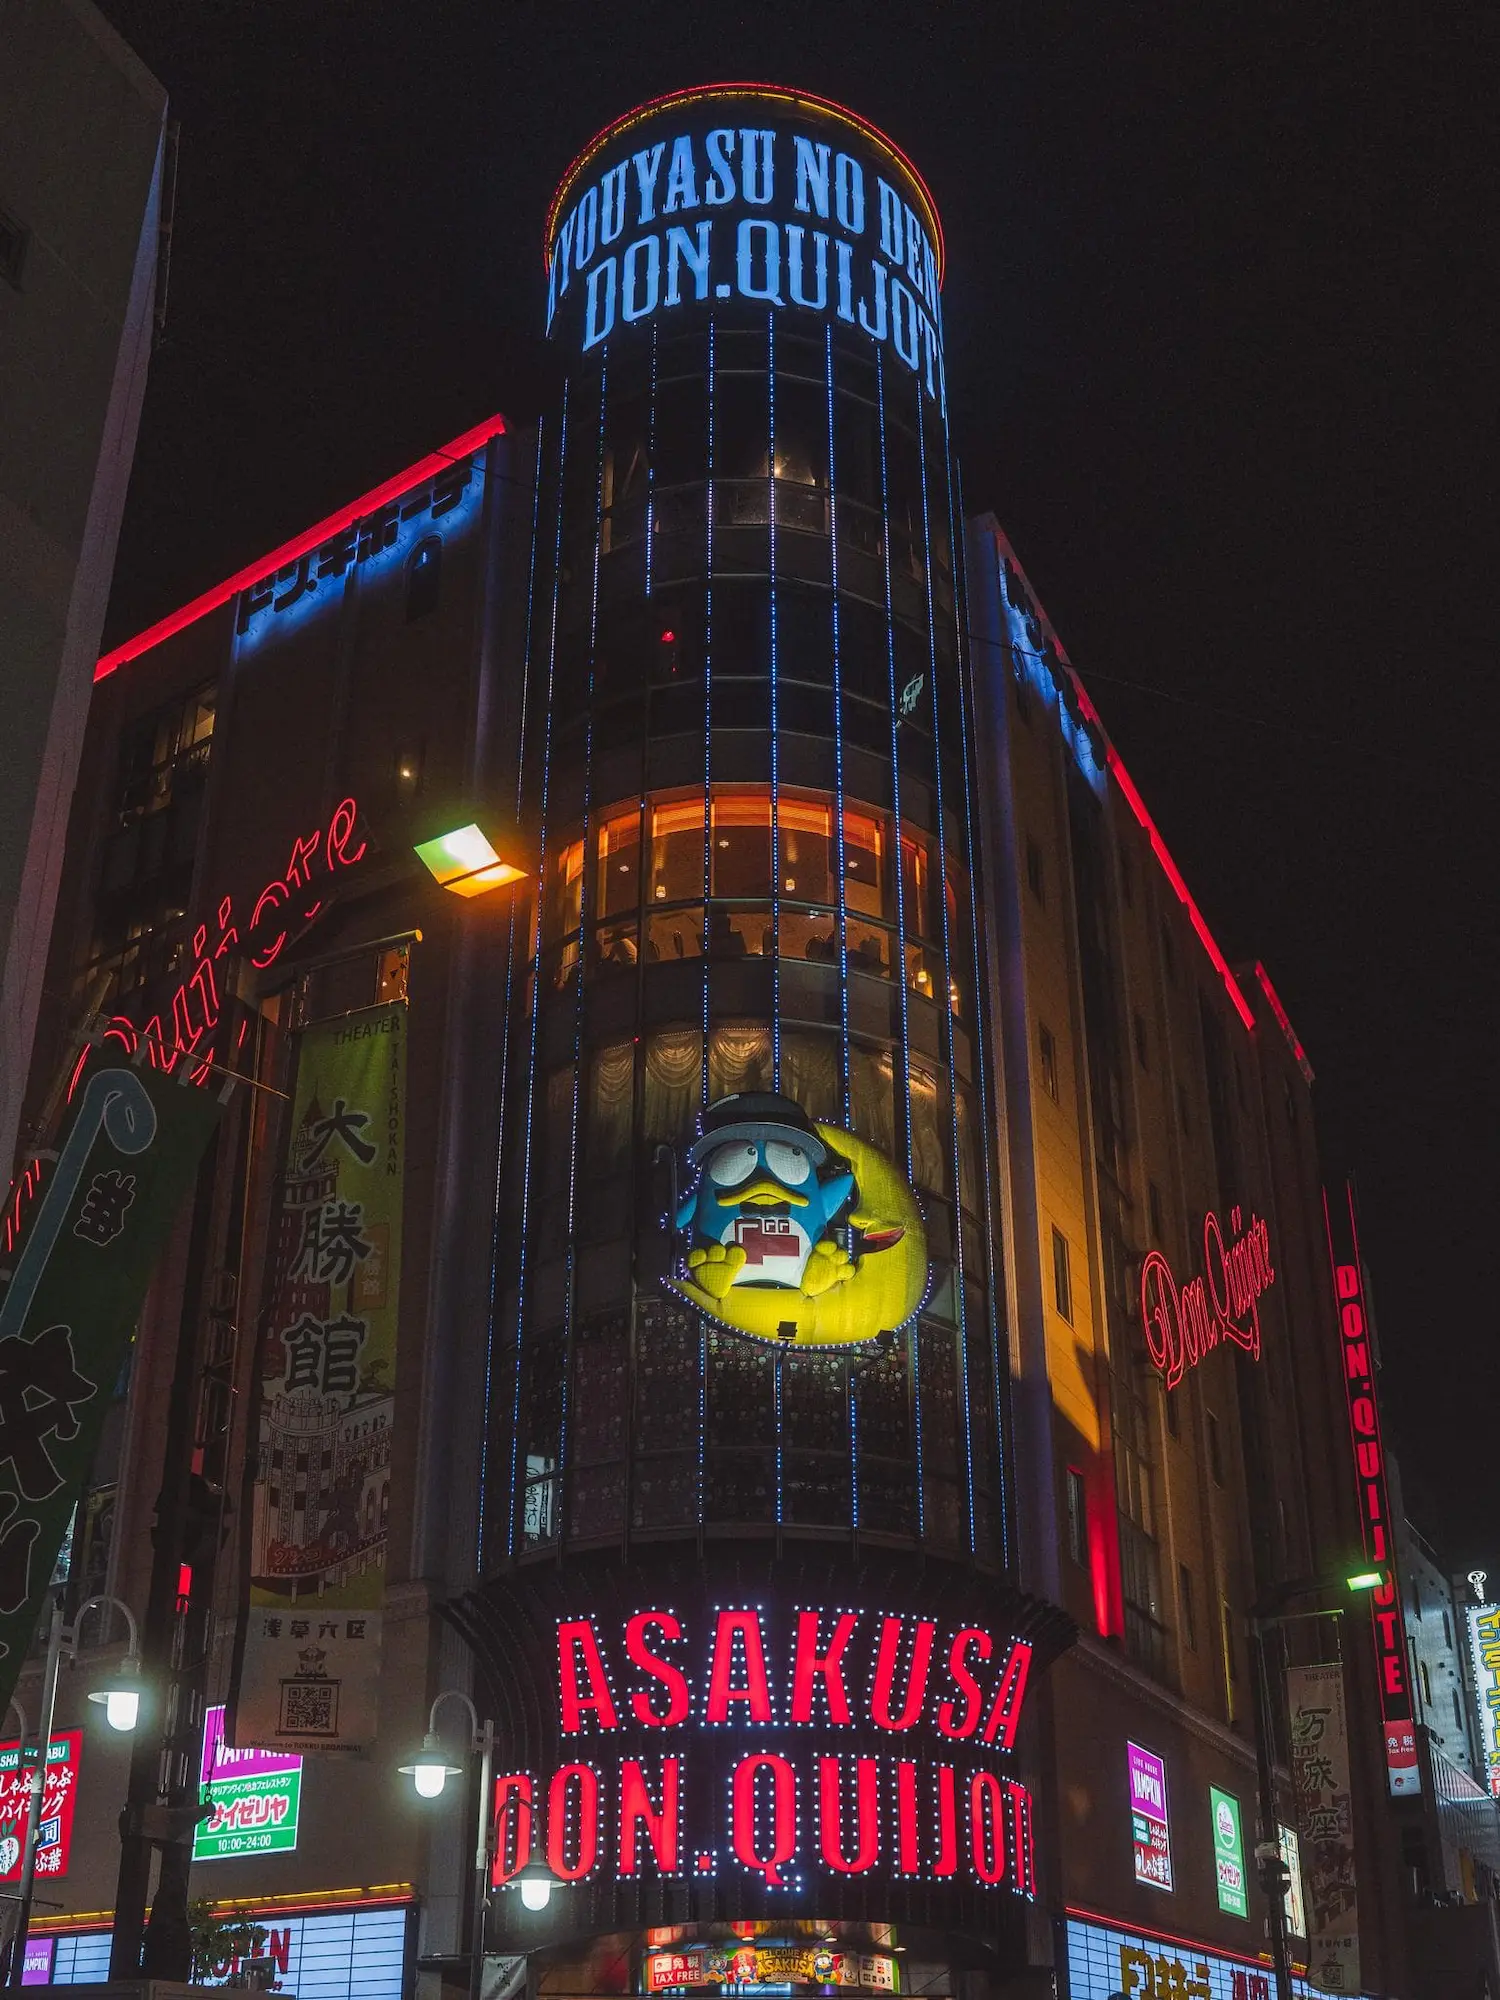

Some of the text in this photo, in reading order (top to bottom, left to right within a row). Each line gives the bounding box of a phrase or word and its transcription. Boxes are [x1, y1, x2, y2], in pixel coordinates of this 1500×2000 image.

[793, 136, 865, 235] NO
[334, 1016, 400, 1046] THEATER
[386, 1043, 400, 1176] TAISHOKAN
[284, 1099, 376, 1396] 大勝館
[556, 1608, 1033, 1750] ASAKUSA
[0, 1766, 74, 1797] しゃぶゃぶ
[0, 1790, 68, 1821] バイング
[218, 1834, 272, 1852] 10:00-24:00
[755, 1949, 800, 1960] WELCOME
[803, 1951, 815, 1961] to
[757, 1959, 815, 1976] ASAKUSA
[654, 1970, 700, 1984] TAX FREE
